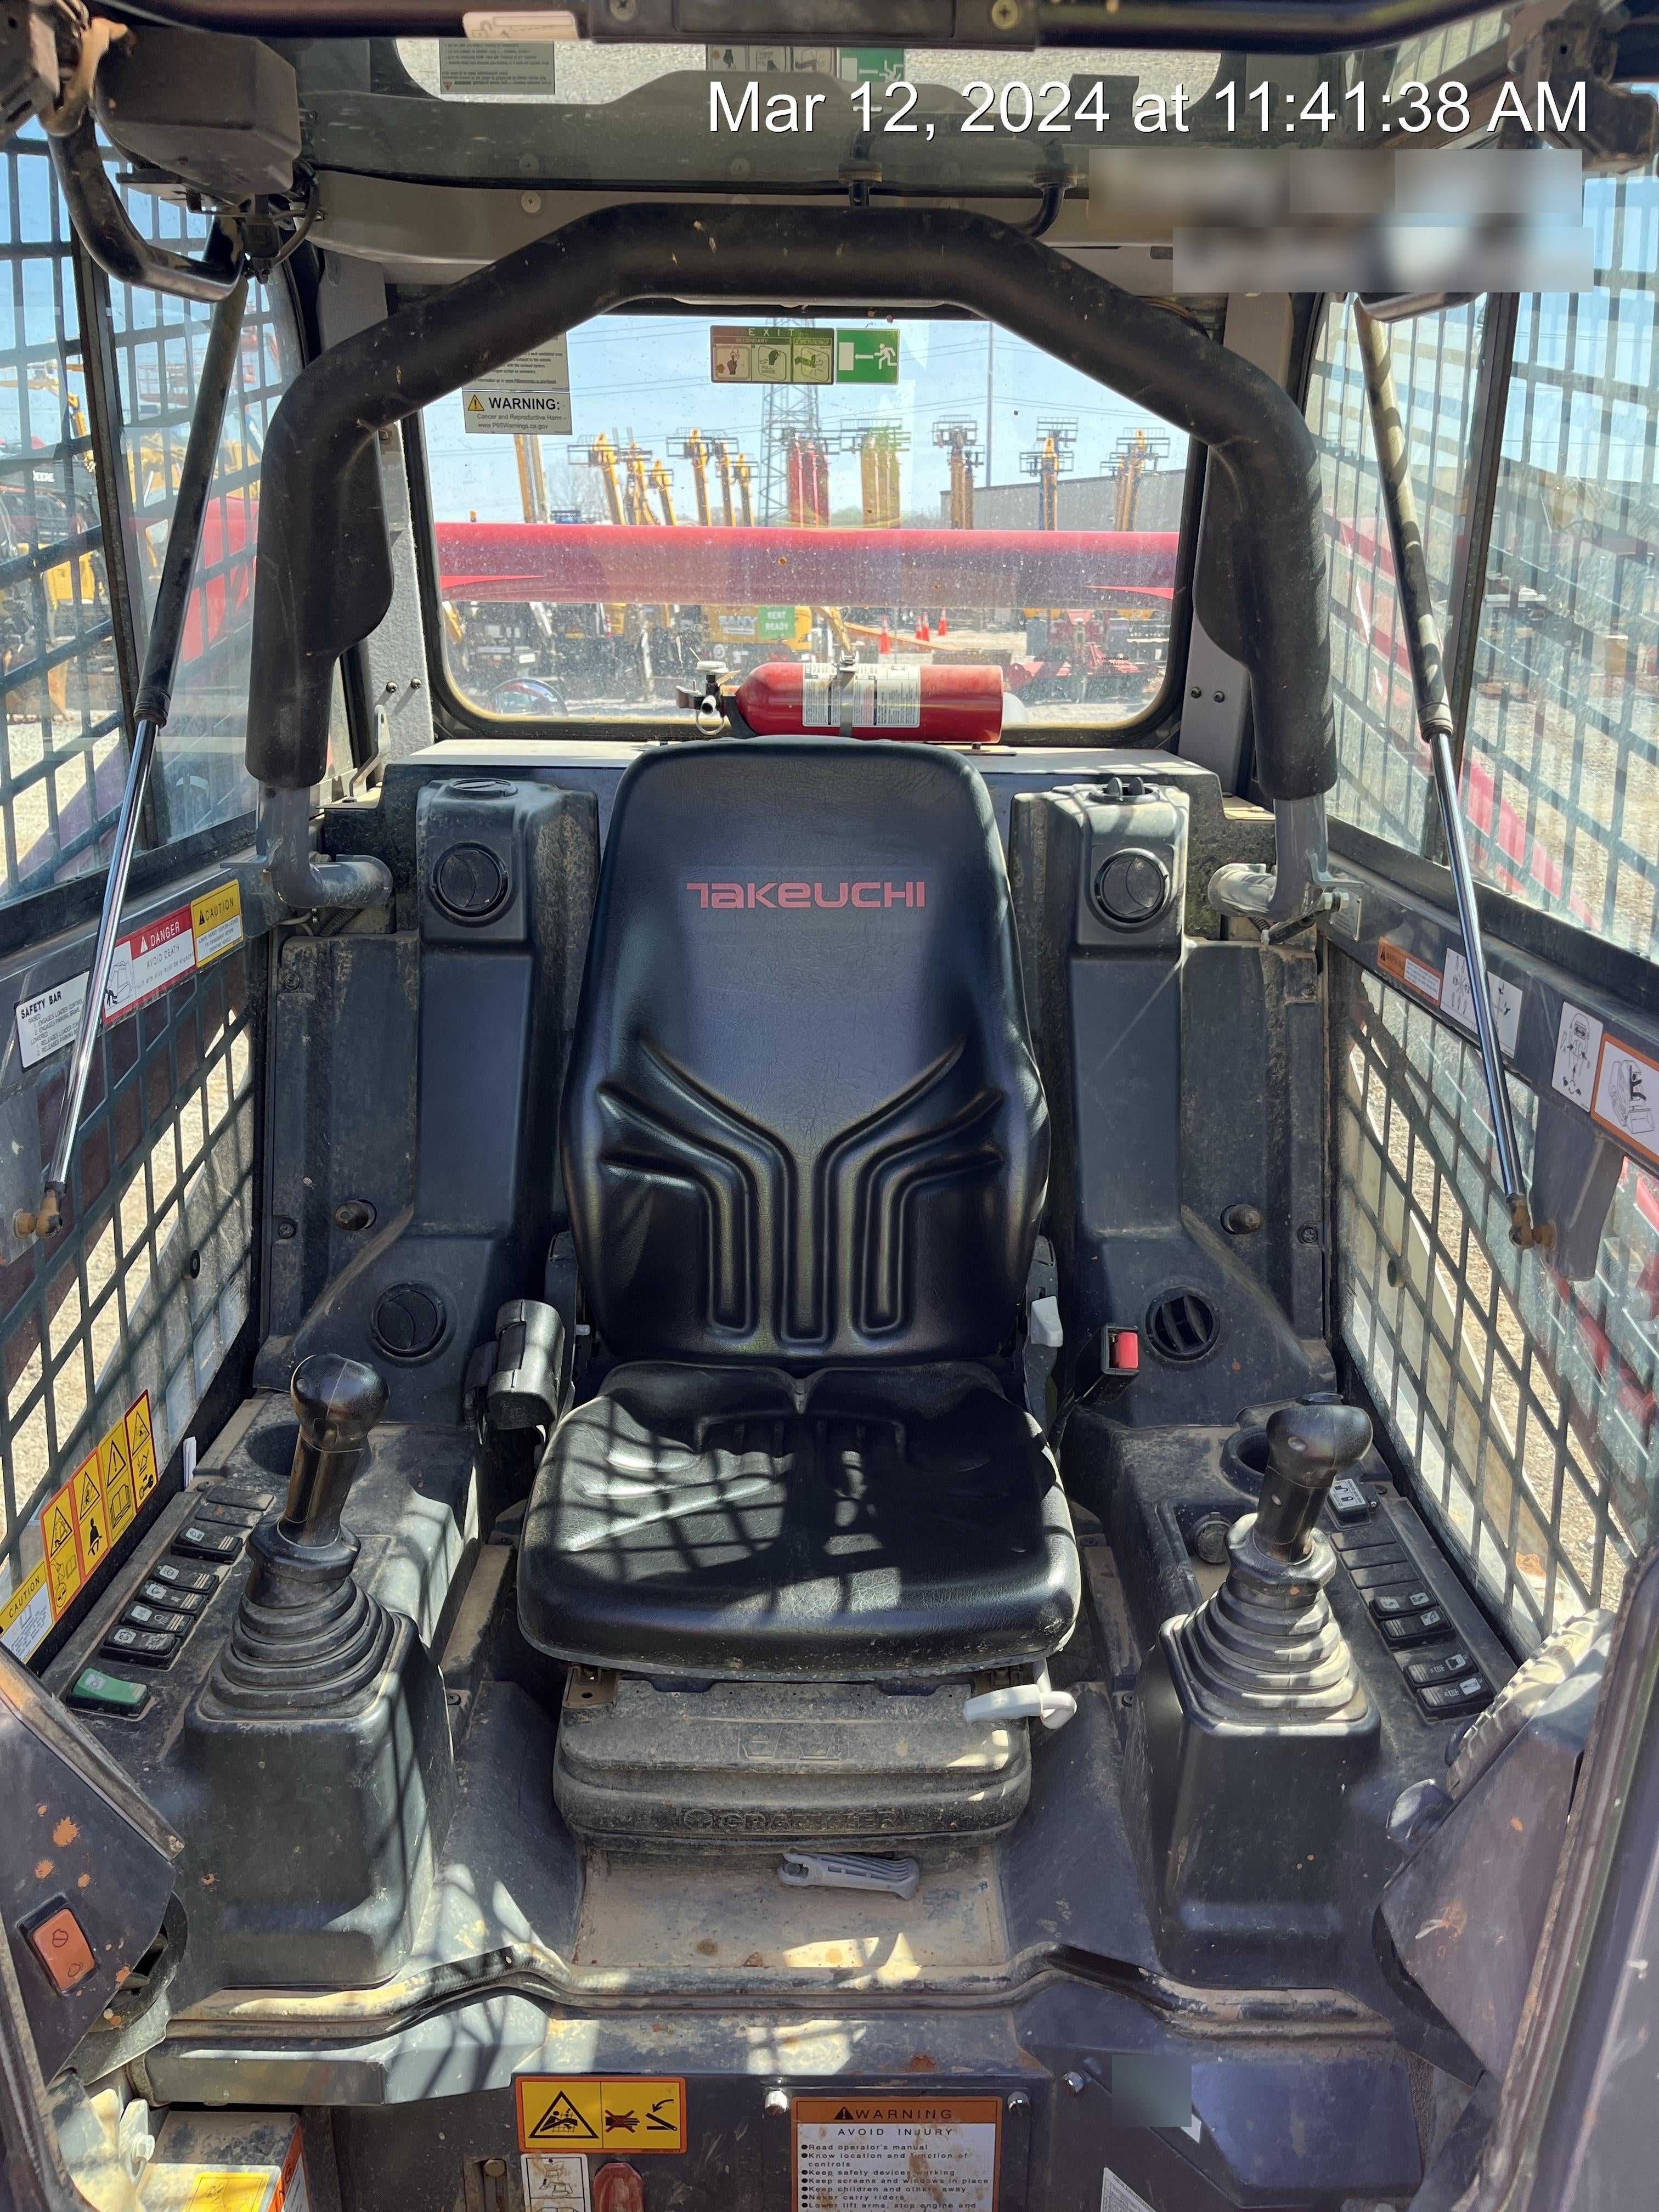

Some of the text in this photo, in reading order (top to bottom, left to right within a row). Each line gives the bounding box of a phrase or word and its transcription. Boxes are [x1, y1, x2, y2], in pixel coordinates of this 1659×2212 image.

[748, 328, 795, 336] EXIT
[488, 397, 560, 410] WARNING:
[767, 611, 787, 619] RENT
[765, 623, 789, 631] READY
[205, 898, 234, 921] CAUTION
[150, 921, 180, 947] DANGER
[146, 943, 180, 969] AVOID DEATH
[20, 991, 62, 1019] SAFETY BAR
[9, 1575, 40, 1618] CAUTION
[855, 2109, 952, 2119] WARNING
